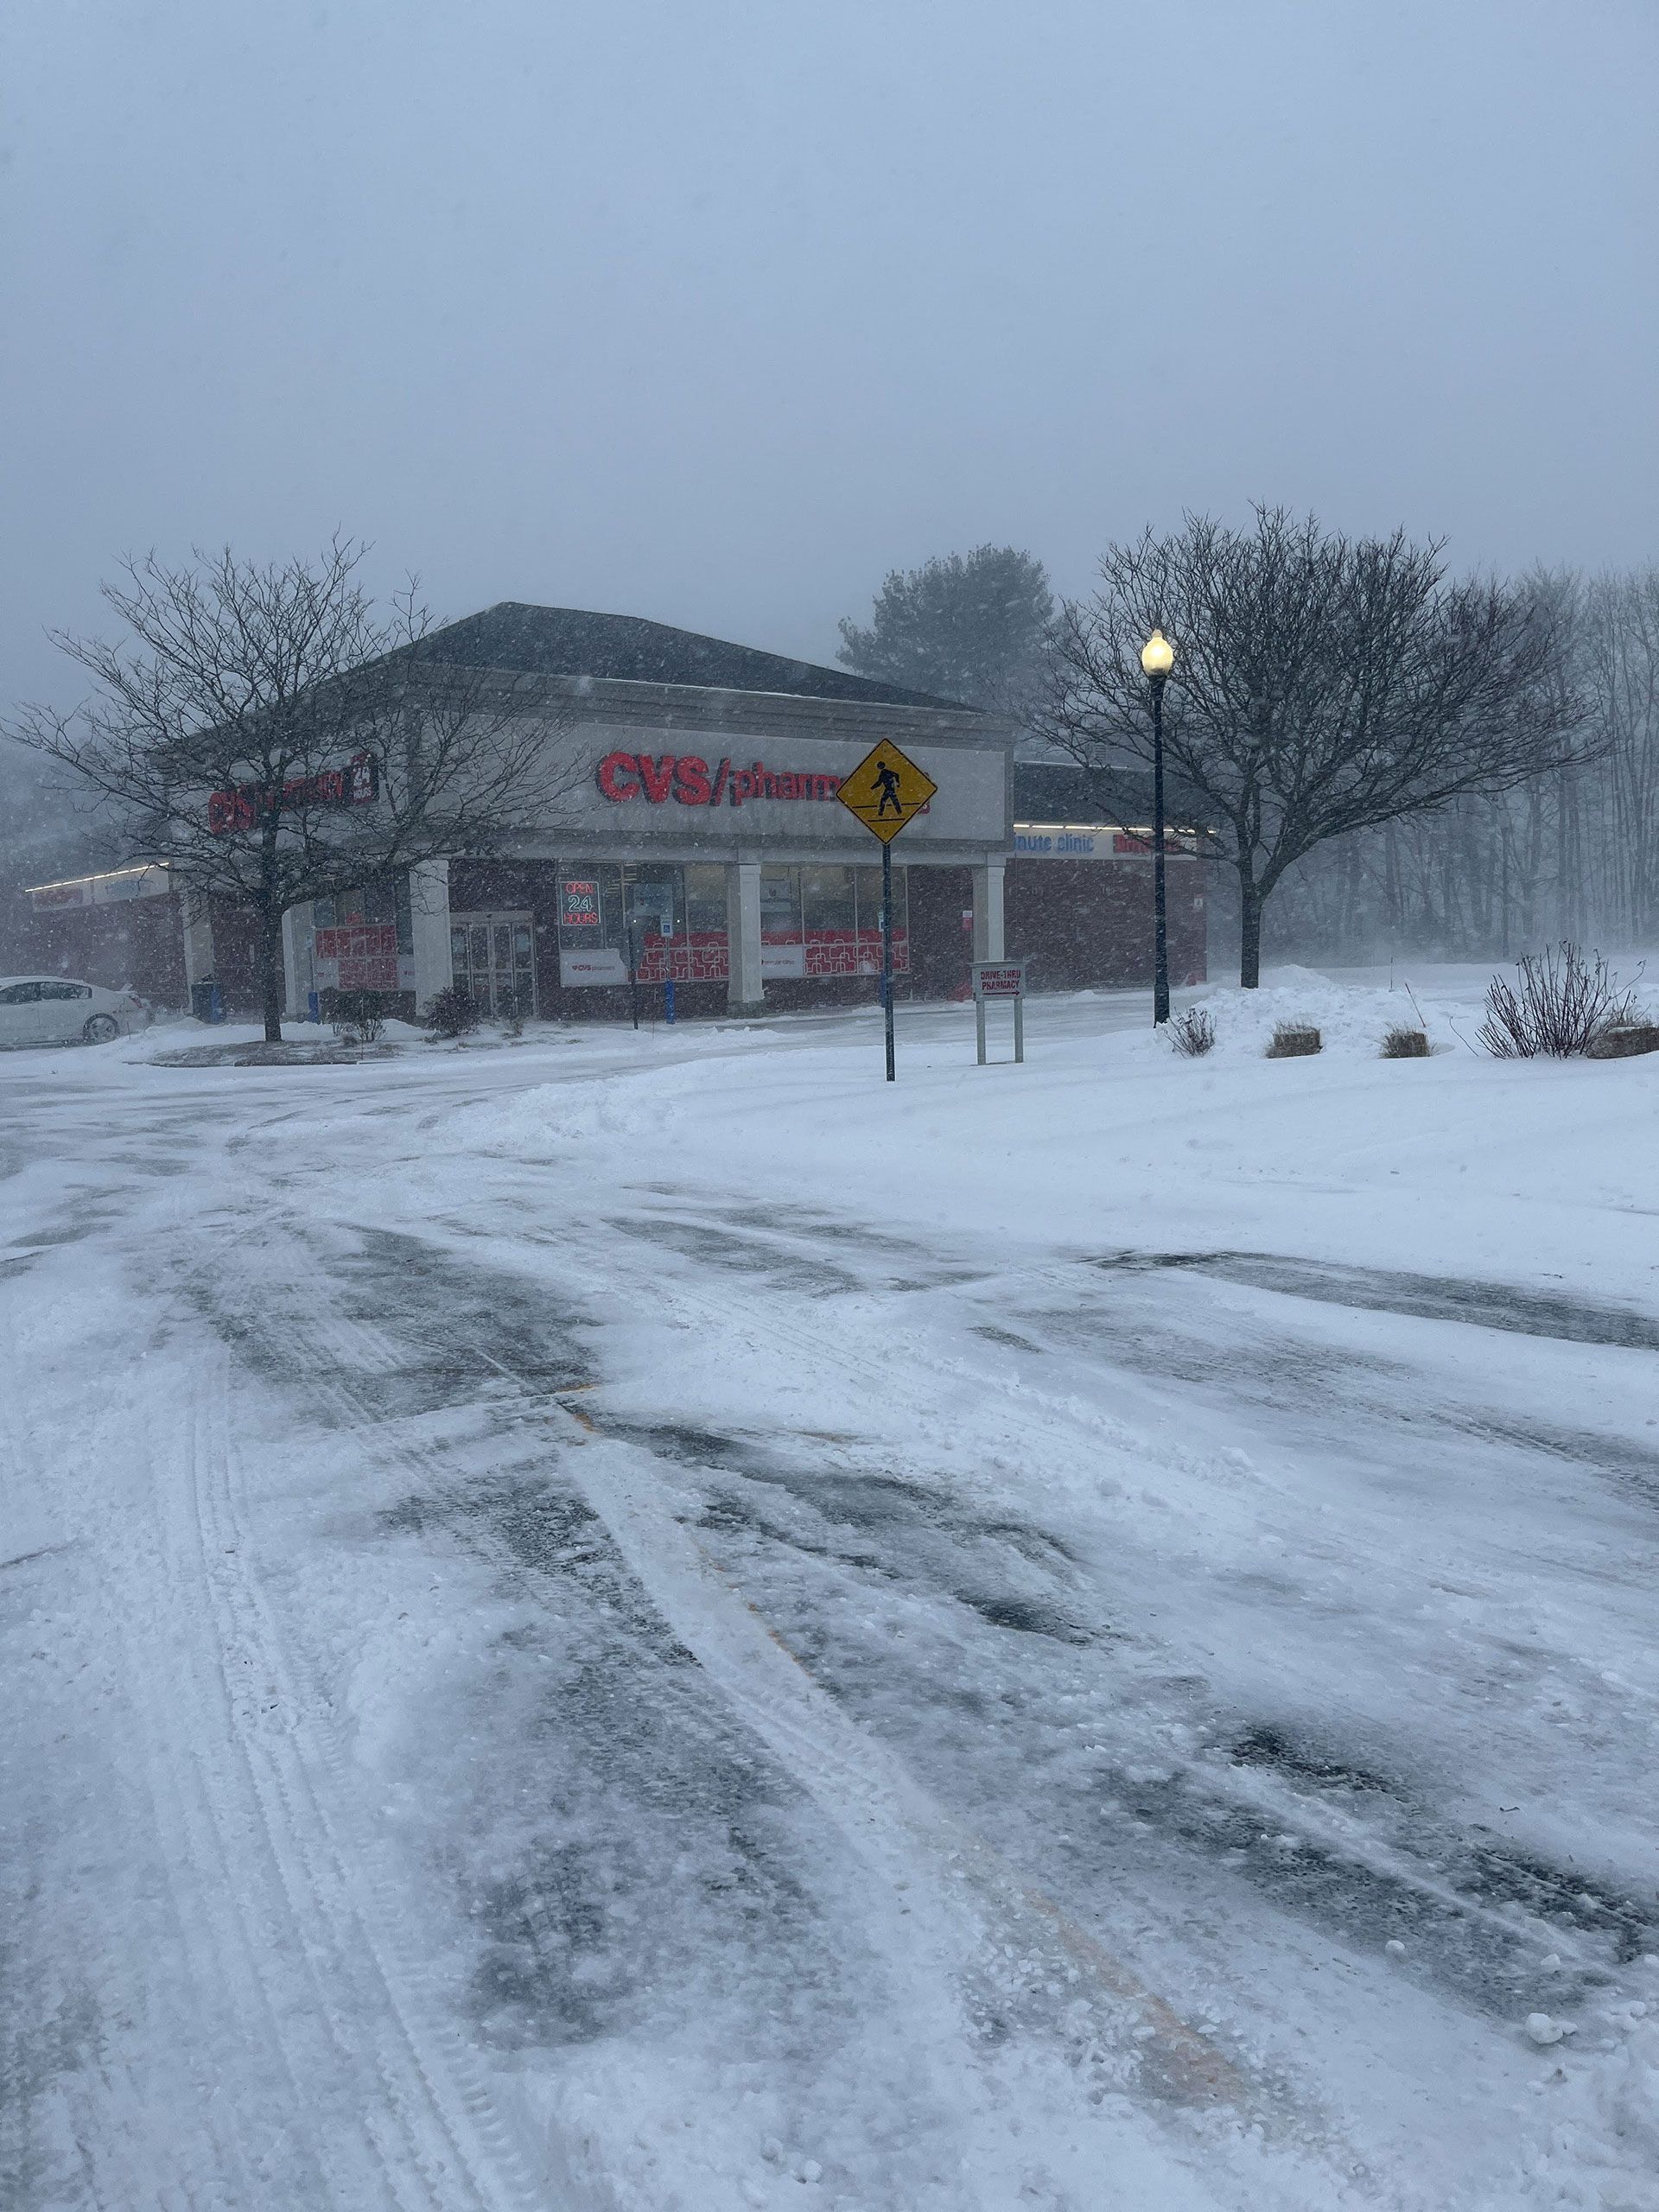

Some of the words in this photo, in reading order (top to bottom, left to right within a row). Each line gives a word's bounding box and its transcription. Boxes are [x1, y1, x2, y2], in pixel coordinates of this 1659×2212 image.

[596, 752, 845, 806] CVS/pharm
[1014, 832, 1052, 851] inute
[1057, 833, 1095, 852] clinic
[564, 882, 594, 893] OPEN
[567, 893, 593, 912] 24
[563, 912, 599, 925] HOURS
[980, 969, 1021, 980] DRIVE-THRU
[982, 980, 1020, 990] PHARMACY
